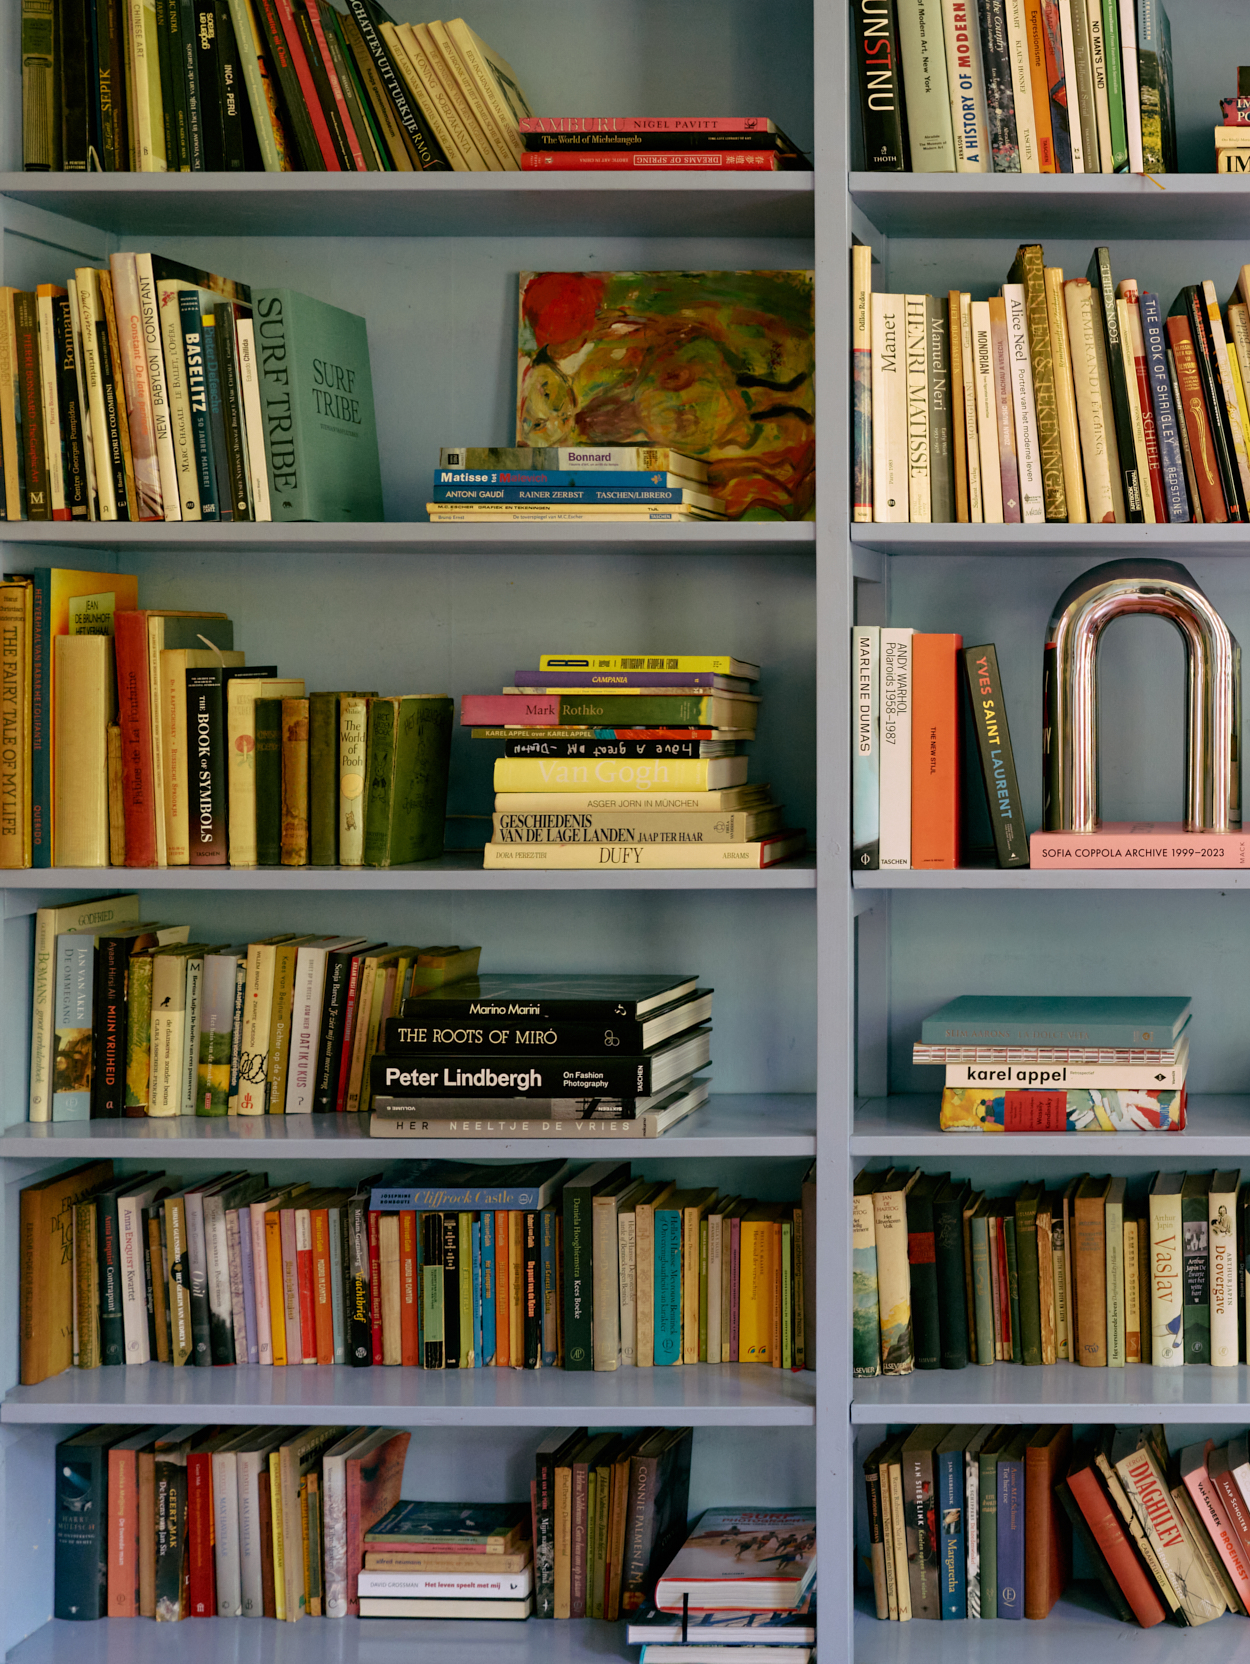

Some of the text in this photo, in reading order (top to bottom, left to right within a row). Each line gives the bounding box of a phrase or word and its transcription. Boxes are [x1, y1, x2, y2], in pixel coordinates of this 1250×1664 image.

[1031, 10, 1041, 67] Expressionisme
[1091, 20, 1105, 89] NO MAN'S LAND
[100, 67, 112, 112] SEPIK
[224, 64, 236, 117] INCA PERÚ
[952, 2, 980, 163] A HISTORY OF MODERN
[520, 117, 719, 132] SAMBURU NIGEL PAVITT
[542, 135, 643, 146] The World of Michelangelo
[880, 313, 897, 374] Manet
[977, 330, 990, 375] MONDRIAN
[1010, 298, 1028, 362] Alice Neel
[139, 275, 170, 440] NEW BABYLON CONSTANT
[185, 332, 207, 413] BASELITZ
[312, 358, 356, 393] SURF
[1145, 299, 1176, 445] THE BOOK OF SHRIGLEY
[256, 297, 298, 494] SURF TRIBE
[312, 388, 363, 425] TRIBE
[907, 300, 928, 479] HENRI MATISSE
[1142, 411, 1160, 471] SCHIELE
[440, 472, 548, 483] Matisse Malevich
[445, 489, 672, 499] ANTONI GAUDÍ RAINER ZERBST TASCHEN/LIBRERO
[859, 637, 871, 752] MARLENE DUMAS
[885, 642, 897, 745] Polaroids 1958–1987
[896, 643, 907, 716] ANDY WARHOL
[525, 704, 604, 716] Mark Rothko
[976, 656, 1012, 820] YVES SAINT LAURENT
[197, 695, 214, 844] THE BOOK OF SYMBOLS
[537, 760, 669, 790] Van Gogh
[499, 814, 593, 829] GESCHIEDENIS
[499, 828, 636, 842] VAN DE LAGE LANDEN
[599, 847, 644, 864] DUFY
[1041, 847, 1225, 859] SOFIA COPPOLA ARCHIVE 1999–2023
[469, 1003, 541, 1015] Marino Marini
[105, 1005, 117, 1086] MIJN VRIJHEID
[398, 1028, 558, 1045] THE ROOTS OF MIRÓ
[385, 1067, 542, 1091] Peter Lindbergh
[563, 1071, 604, 1079] On Fashion
[563, 1079, 609, 1089] Photography
[967, 1066, 1067, 1085] karel appel
[396, 1121, 630, 1131] HER NEELTJE DE VRIES
[414, 1189, 515, 1209] Cliffrock Castle
[355, 1269, 366, 1323] Vrachtbrief
[1153, 1235, 1179, 1304] Vaslav
[1213, 1244, 1225, 1315] De overgave
[169, 1488, 177, 1549] GEERT MAK
[1129, 1460, 1185, 1549] DIAGHILEV
[947, 1538, 959, 1594] Margaretha
[1219, 1530, 1249, 1582] BROEINEST
